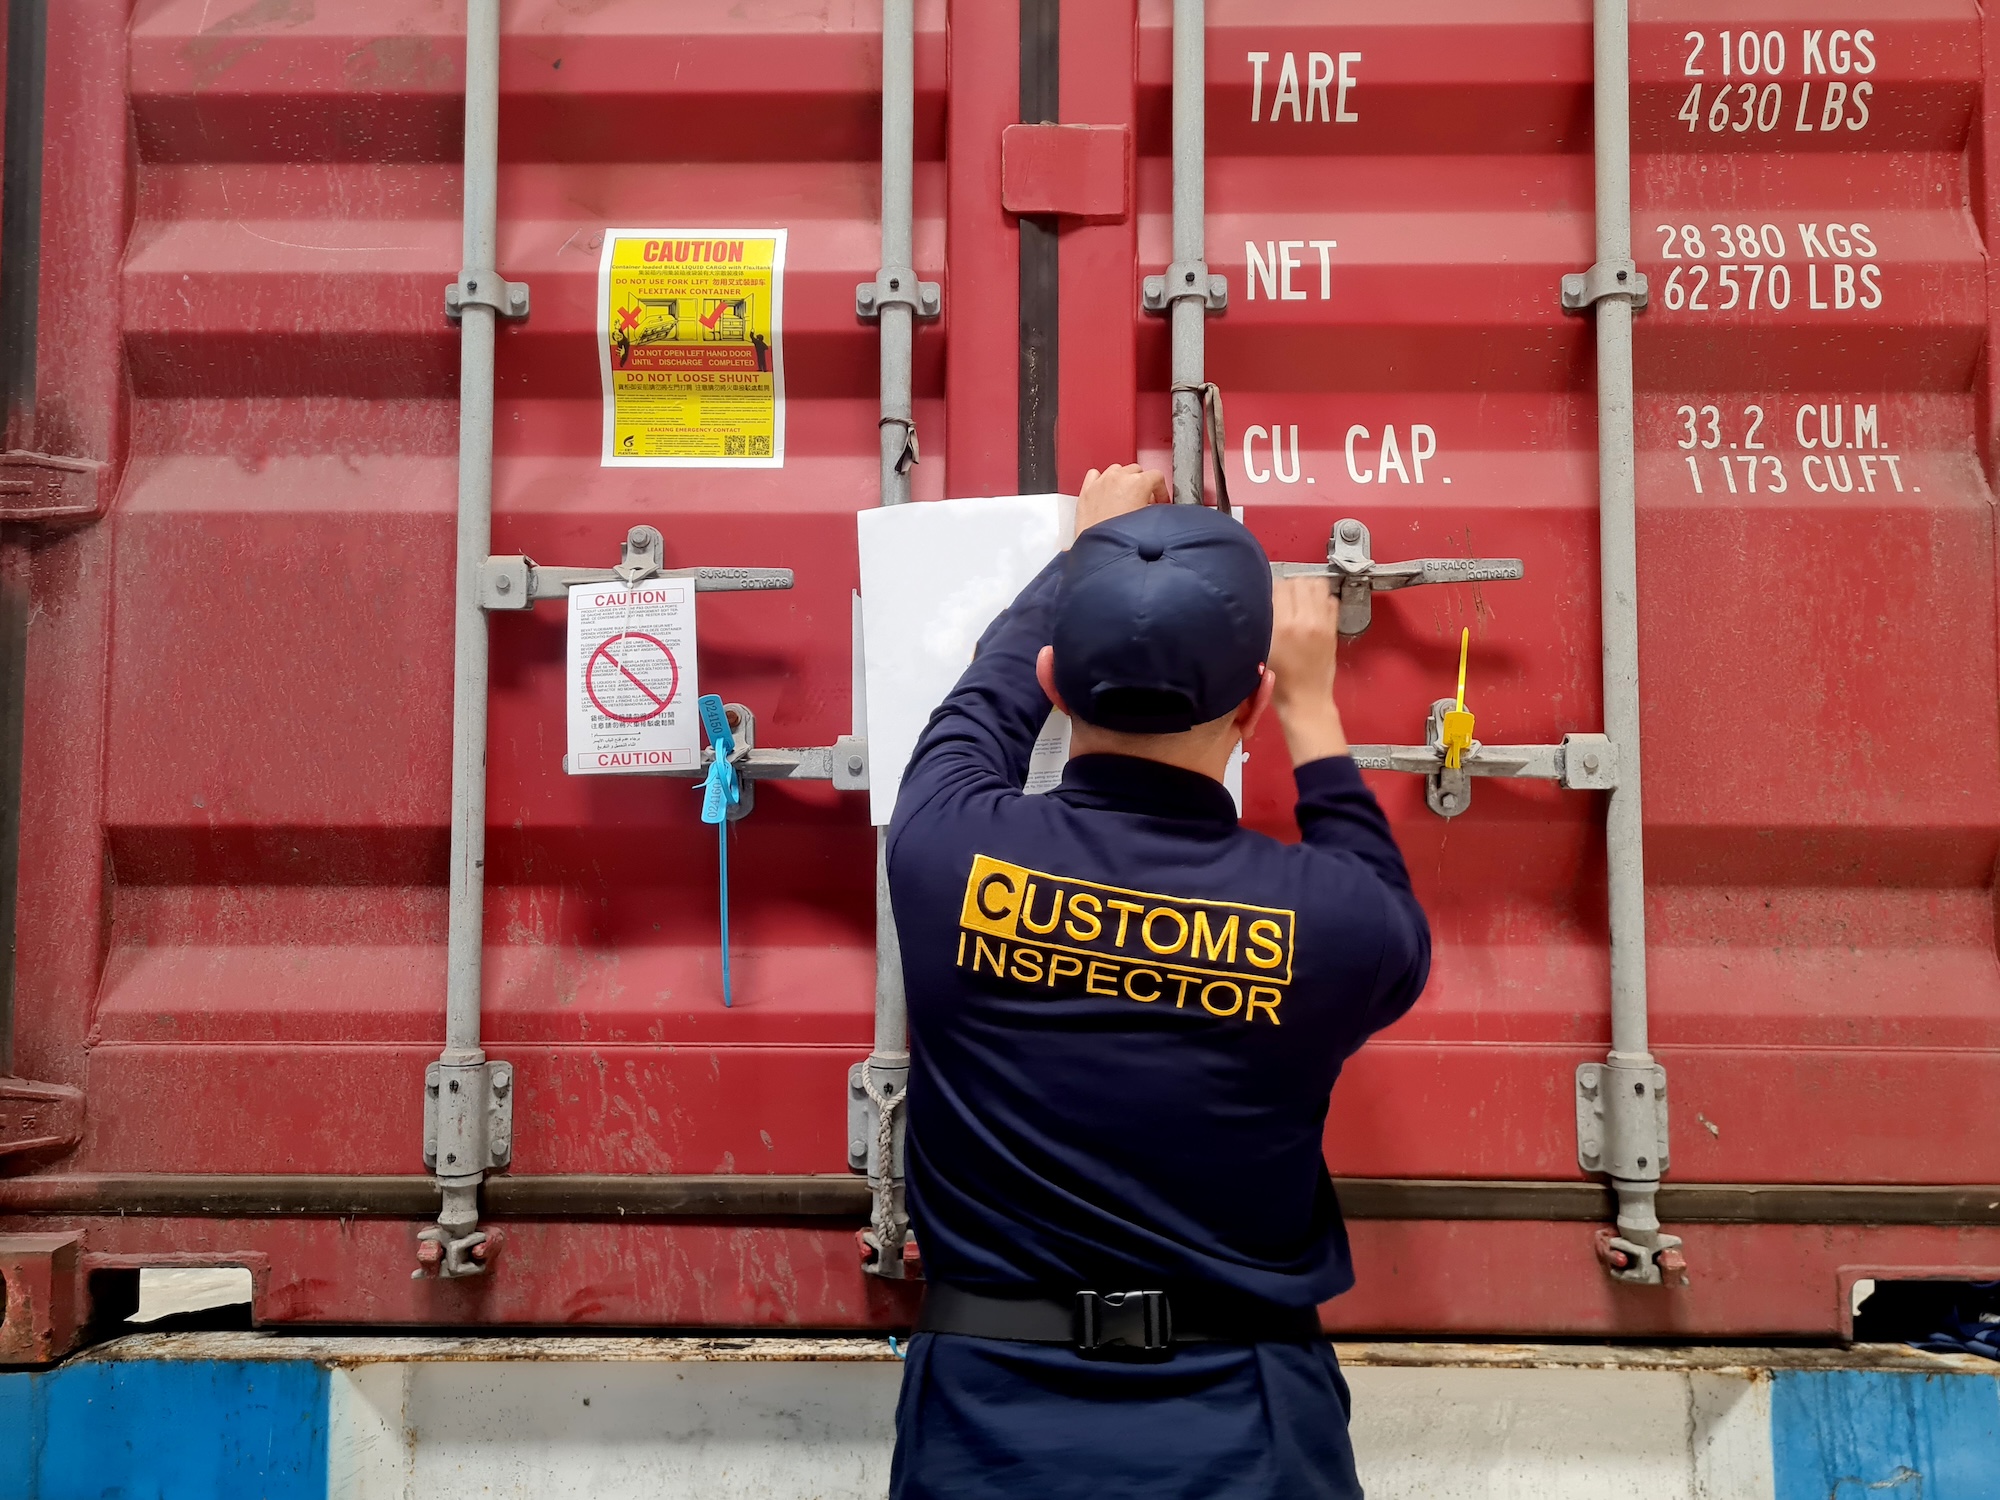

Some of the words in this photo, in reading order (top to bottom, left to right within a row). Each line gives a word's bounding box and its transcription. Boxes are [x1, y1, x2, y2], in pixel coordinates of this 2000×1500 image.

[1804, 29, 1876, 74] KGS
[1247, 52, 1362, 122] TARE
[1795, 81, 1874, 132] LBS
[644, 240, 744, 262] CAUTION
[1798, 223, 1878, 258] KGS
[1244, 240, 1338, 300] NET
[1808, 264, 1882, 310] LBS
[627, 373, 643, 382] DO
[648, 373, 672, 382] NOT
[676, 373, 715, 382] LOOSE
[719, 374, 759, 383] SHUNT
[1676, 404, 1764, 449] 33.2
[1796, 404, 1888, 449] CU.M.
[1242, 425, 1315, 484] CU.
[1344, 424, 1452, 484] CAP.
[1802, 455, 1921, 492] CU.FT.
[700, 569, 748, 578] SURALOC
[740, 577, 789, 588] SURALOC
[1426, 561, 1475, 571] SURALOC
[1467, 568, 1517, 580] SURALOC
[595, 591, 666, 606] CAUTION
[705, 699, 723, 734] 024150
[598, 751, 672, 766] CAUTION
[976, 872, 1283, 969] CUSTOMS
[956, 932, 1282, 1025] INSPECTOR
